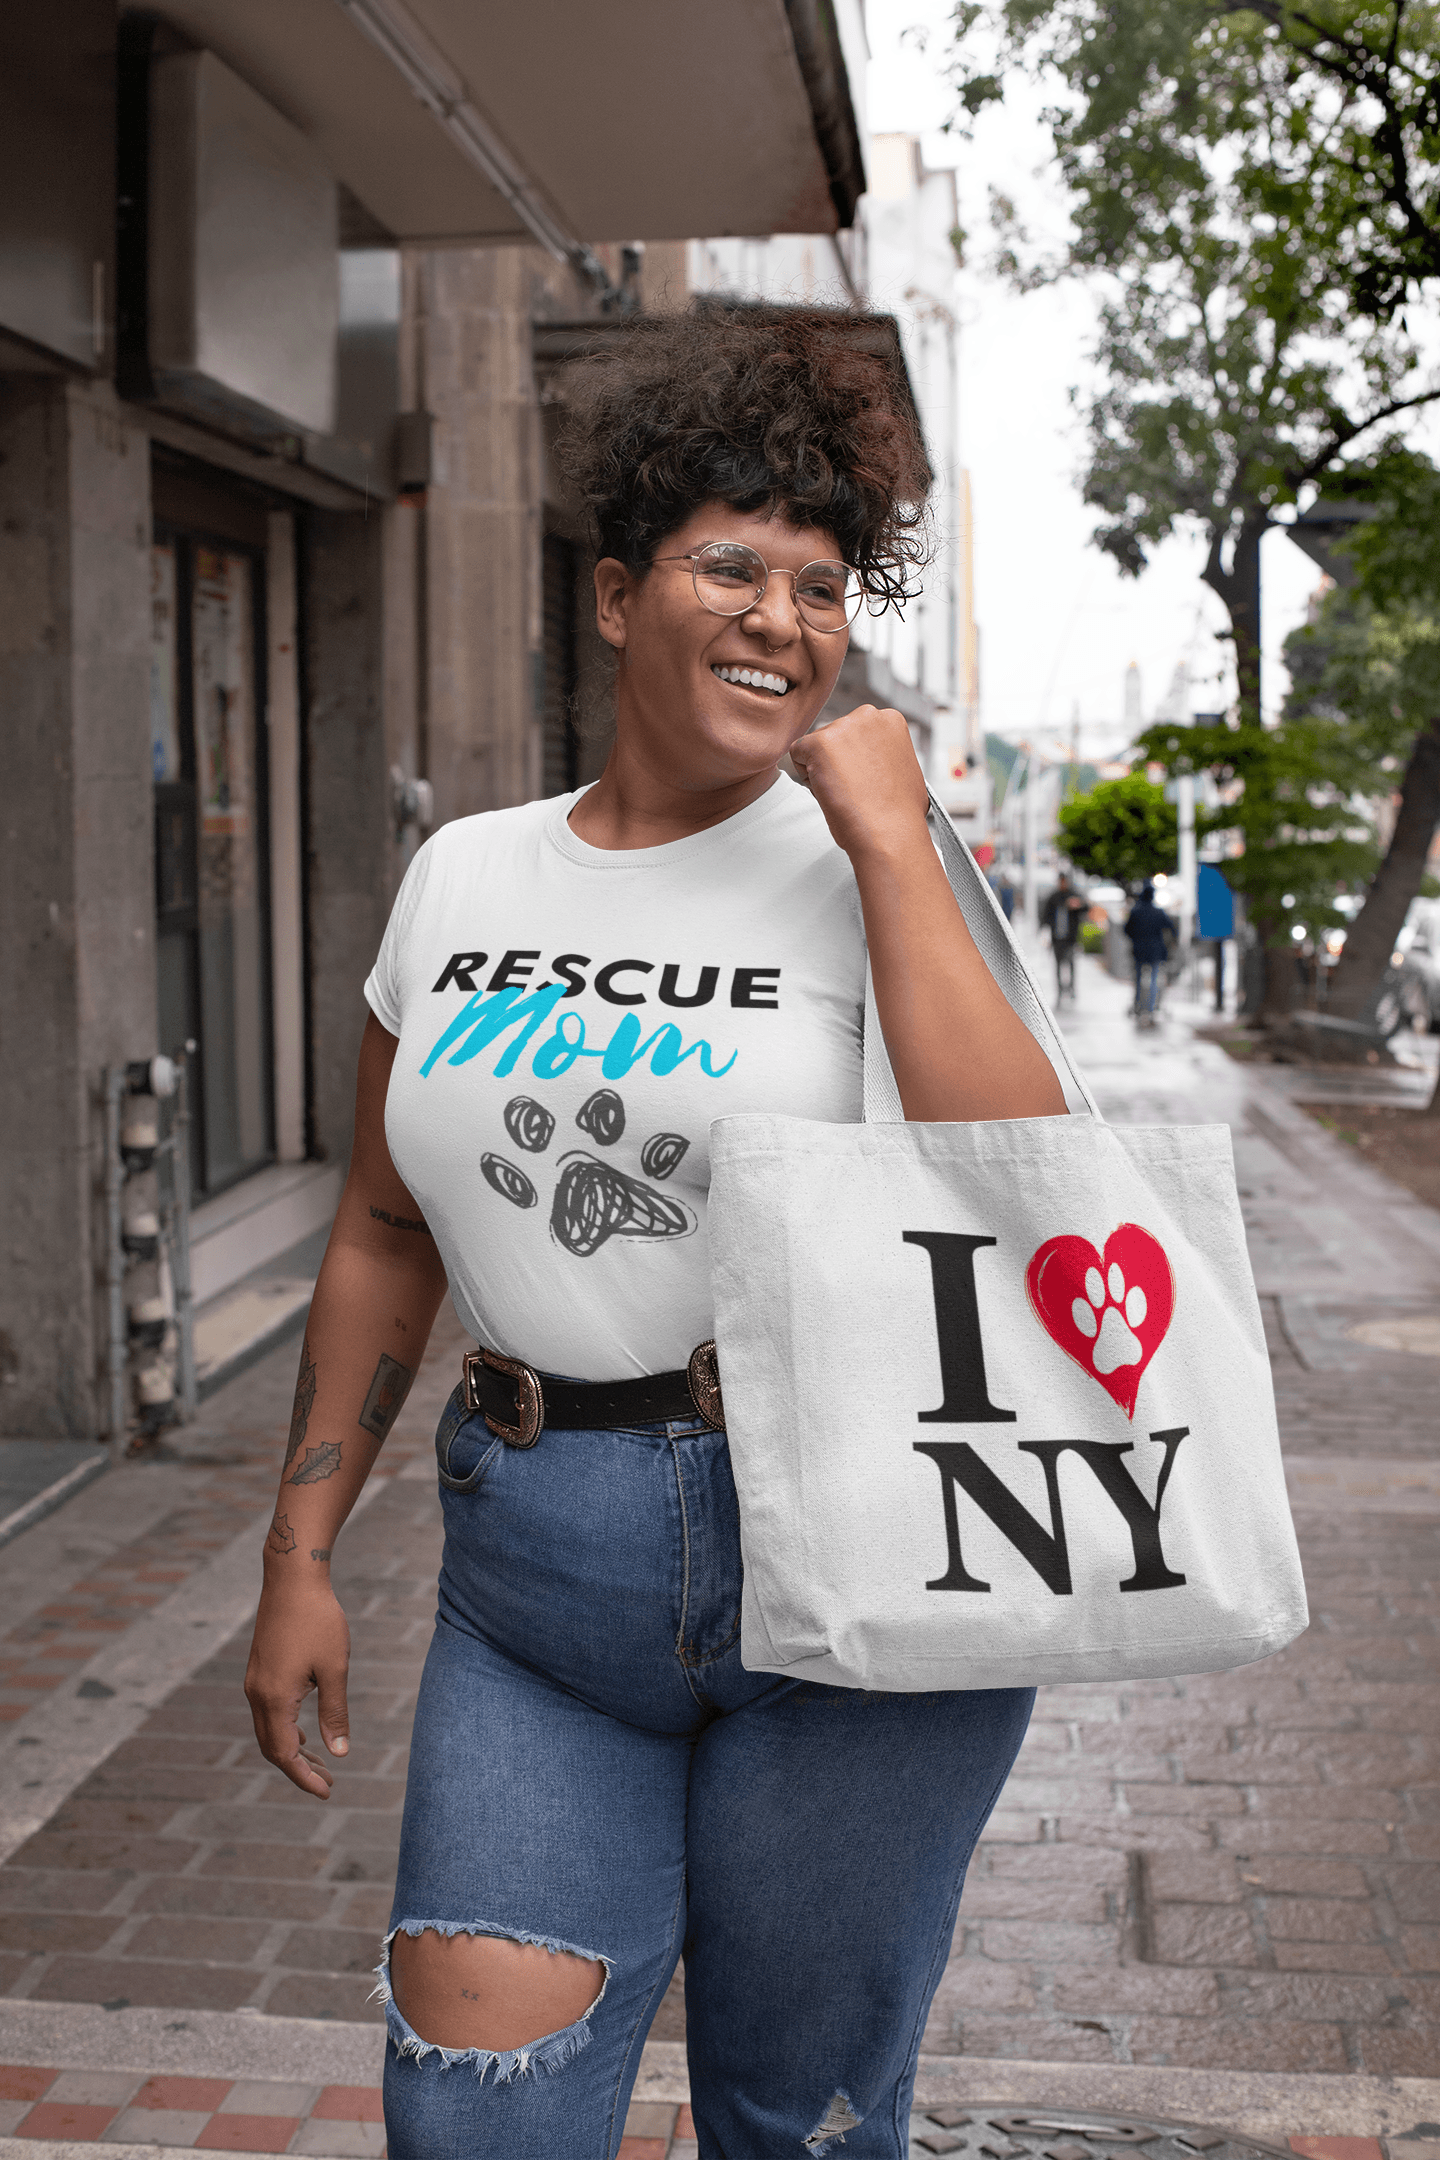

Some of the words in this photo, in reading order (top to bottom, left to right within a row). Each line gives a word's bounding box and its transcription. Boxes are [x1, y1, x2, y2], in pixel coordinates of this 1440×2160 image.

[431, 950, 781, 1009] RESCUE
[418, 983, 738, 1081] Mom
[369, 1205, 433, 1236] VALIENT
[902, 1230, 1017, 1423] I
[913, 1426, 1190, 1595] NY
